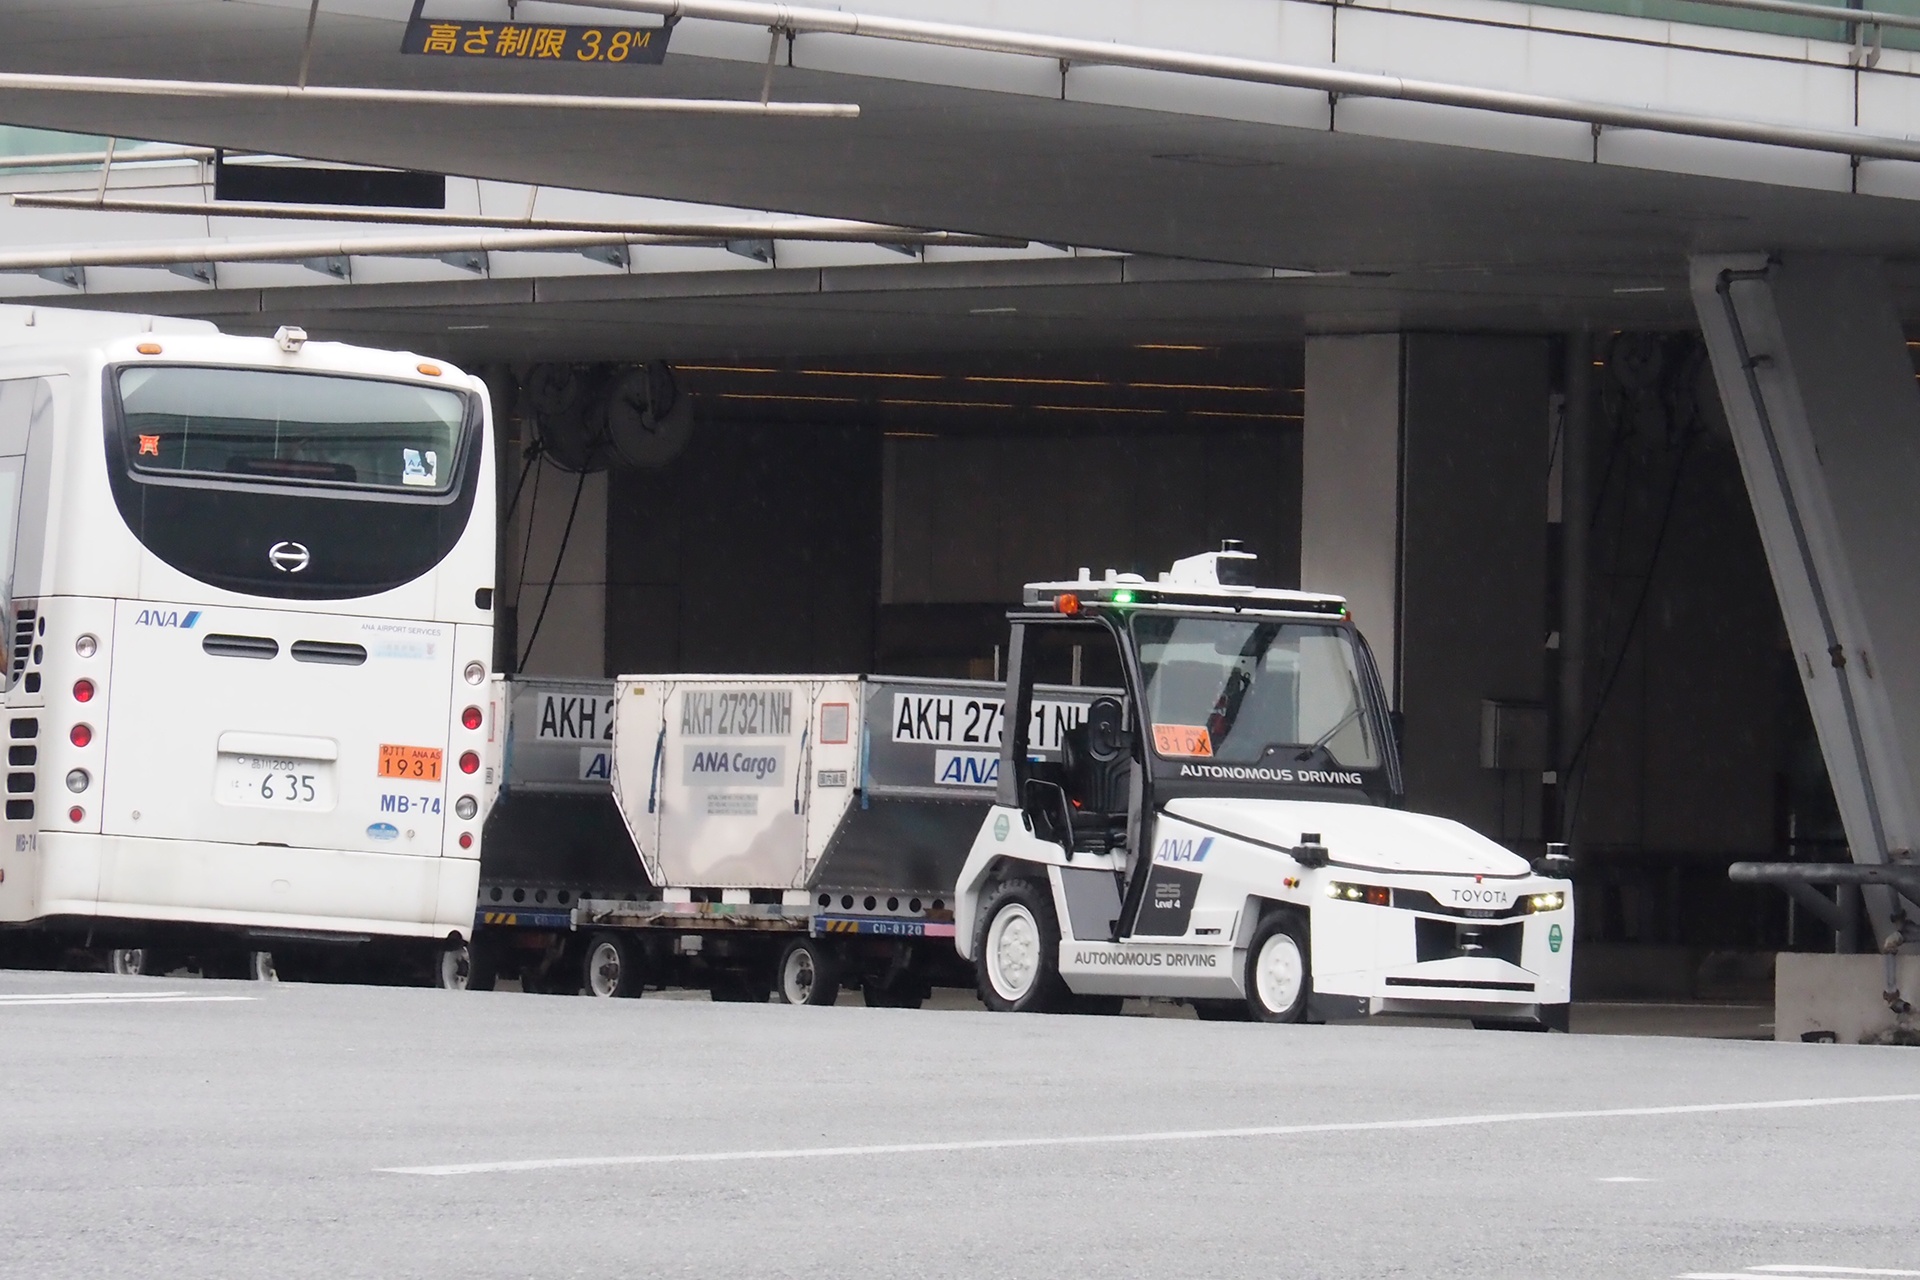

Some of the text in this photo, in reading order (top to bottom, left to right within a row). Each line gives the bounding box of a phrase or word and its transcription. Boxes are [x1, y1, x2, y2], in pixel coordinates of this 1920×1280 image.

[423, 24, 566, 59] 高さ制限
[135, 610, 178, 628] ANA
[361, 623, 441, 637] ANA AIRPORT SERVICES
[540, 696, 597, 739] AKH
[681, 692, 792, 735] AKH 27321 NH
[896, 697, 953, 742] AKH
[963, 701, 1046, 747] 271
[383, 746, 405, 756] RJTT
[412, 750, 428, 759] ANA
[384, 758, 437, 778] 1931
[585, 753, 612, 779] A
[692, 752, 777, 780] ANA Cargo
[1180, 764, 1363, 784] AUTONOMOUS DRIVING
[381, 794, 441, 815] MB-74
[1155, 839, 1193, 862] ANA
[1154, 899, 1181, 909] Level 4
[1452, 889, 1508, 903] TOYOTA
[1074, 952, 1216, 967] AUTONOMOUS DRIVING
